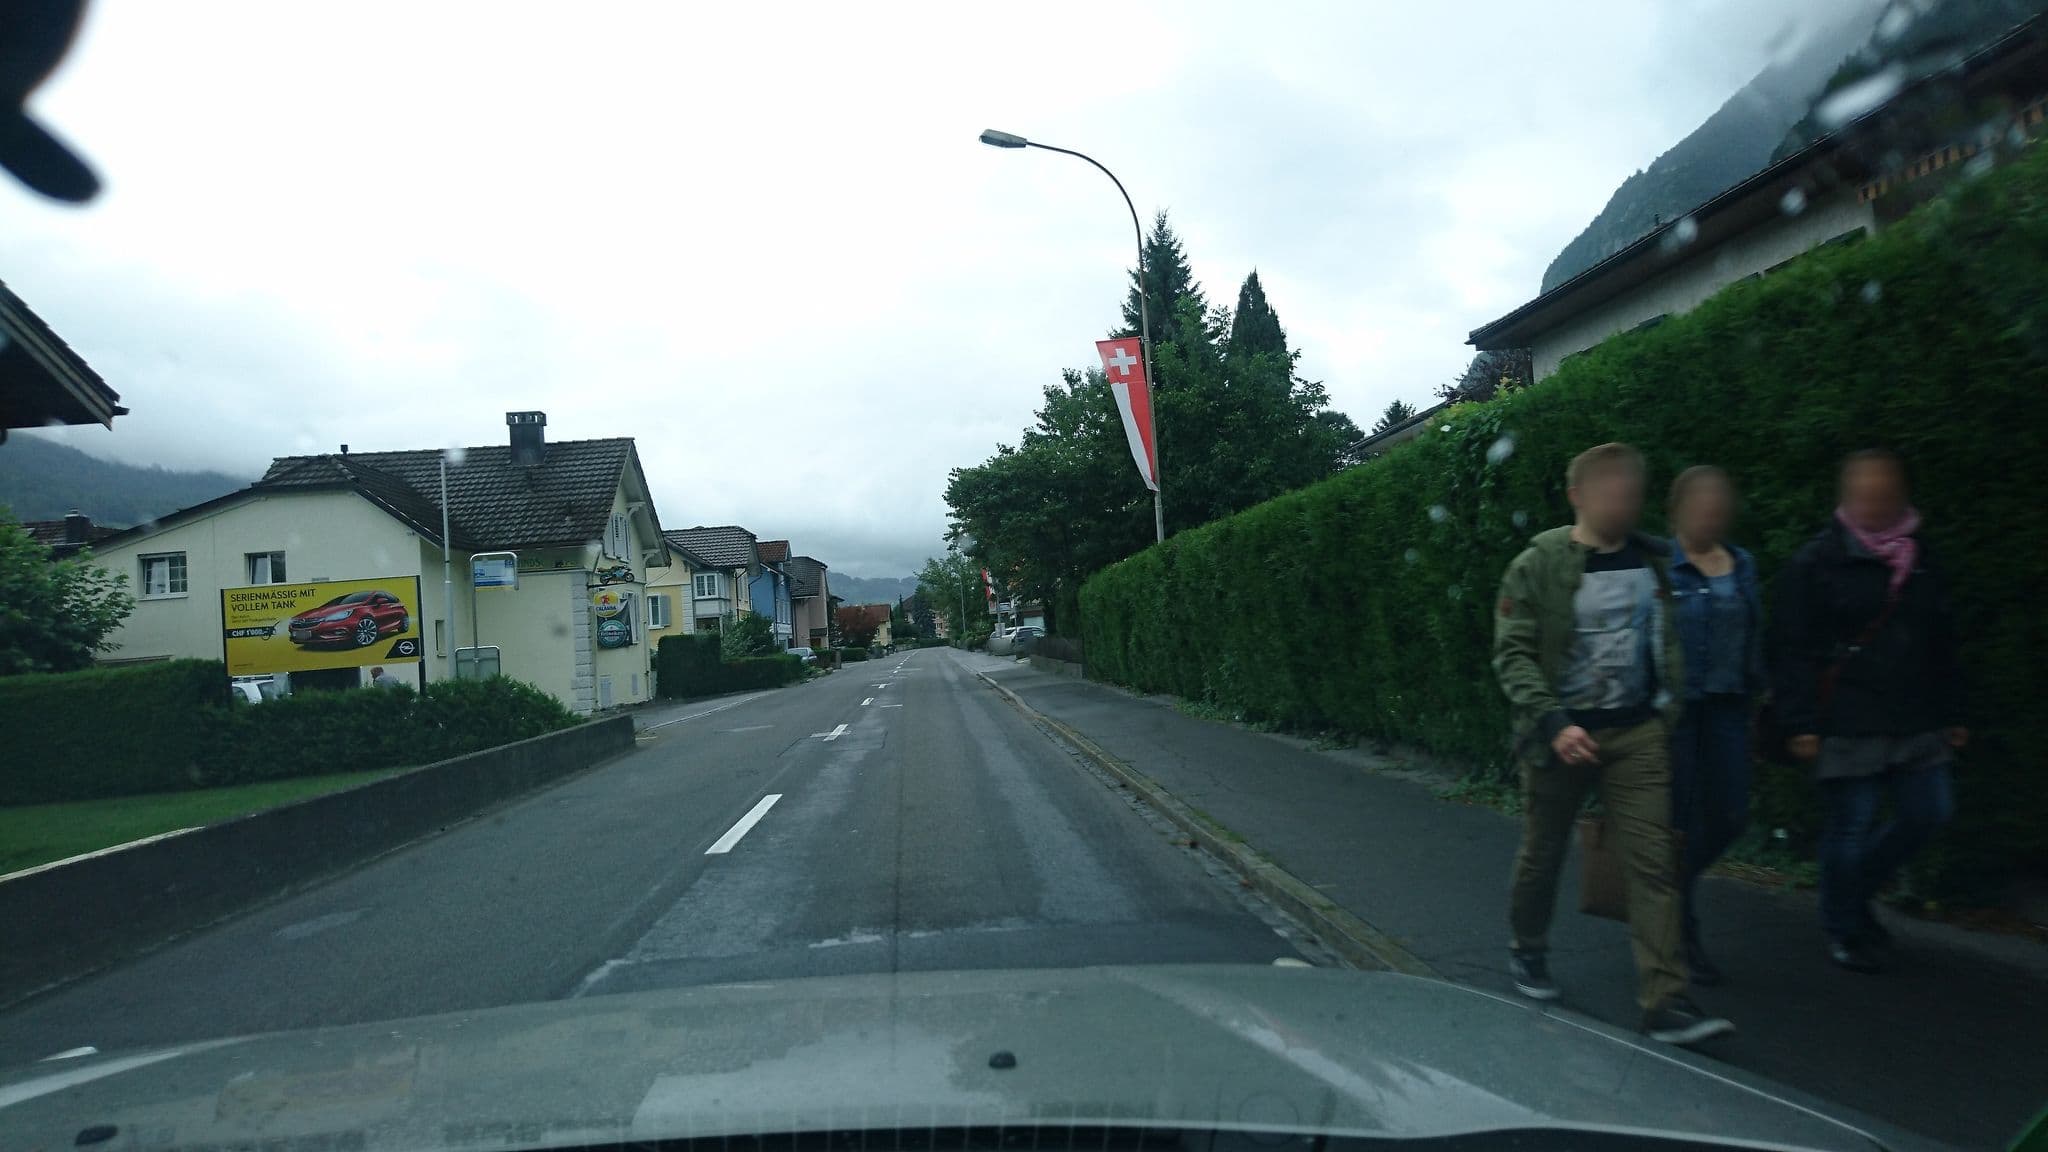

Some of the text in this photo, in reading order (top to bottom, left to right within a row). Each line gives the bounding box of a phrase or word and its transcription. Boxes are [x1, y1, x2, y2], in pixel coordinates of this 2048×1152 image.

[231, 589, 316, 602] SERIENMÄSSIG MIT
[232, 601, 296, 612] VOLLEM TANK
